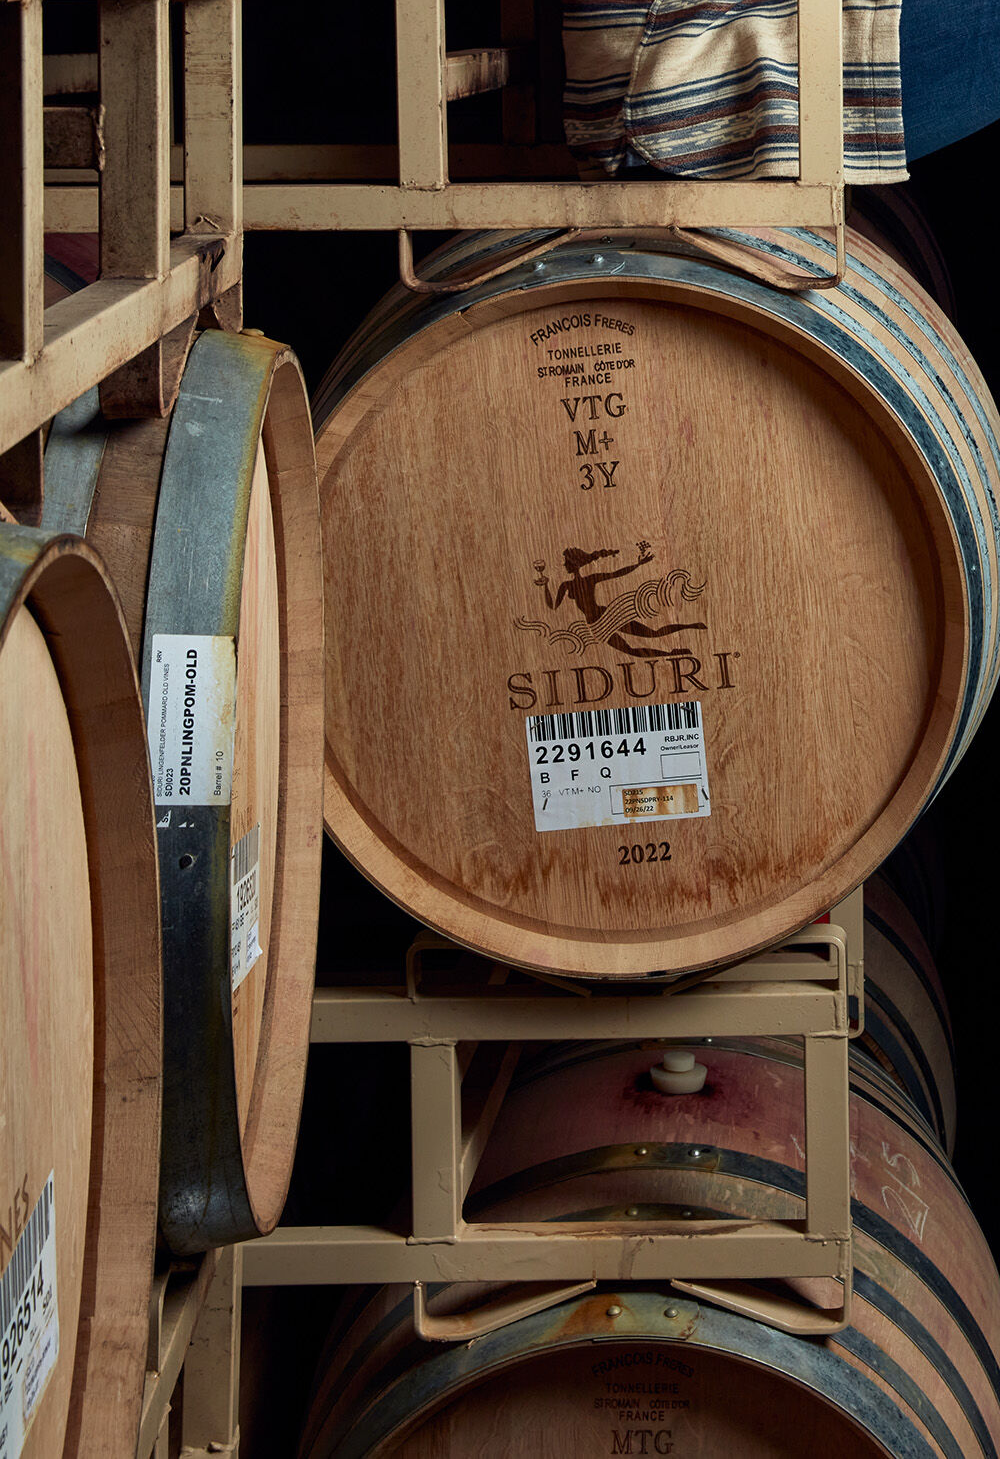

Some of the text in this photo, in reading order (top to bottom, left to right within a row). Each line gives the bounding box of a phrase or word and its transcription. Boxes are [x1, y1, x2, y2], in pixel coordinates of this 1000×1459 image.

[530, 314, 591, 346] FRANÇOIS
[548, 342, 622, 361] TONNELLERIE
[549, 363, 585, 376] ROMAIN
[617, 359, 635, 369] D'OR
[565, 373, 612, 387] FRANCE
[561, 392, 626, 422] VTG
[573, 429, 614, 456] M+
[579, 461, 620, 490] 3Y
[507, 652, 736, 710] SIDURI
[179, 648, 198, 796] 20PNLINGPOM-OLD
[158, 729, 166, 776] LINGENFELDER
[216, 750, 224, 762] 10
[535, 738, 647, 764] 2291644
[213, 773, 223, 797] Barrel
[540, 767, 612, 783] B F Q
[625, 805, 654, 814] 09/26/22
[617, 842, 672, 865] 2022
[0, 1259, 44, 1391] 926514
[606, 1383, 680, 1394] TONNELLERIE
[619, 1410, 665, 1422] FRANCE
[611, 1429, 674, 1455] MTG
